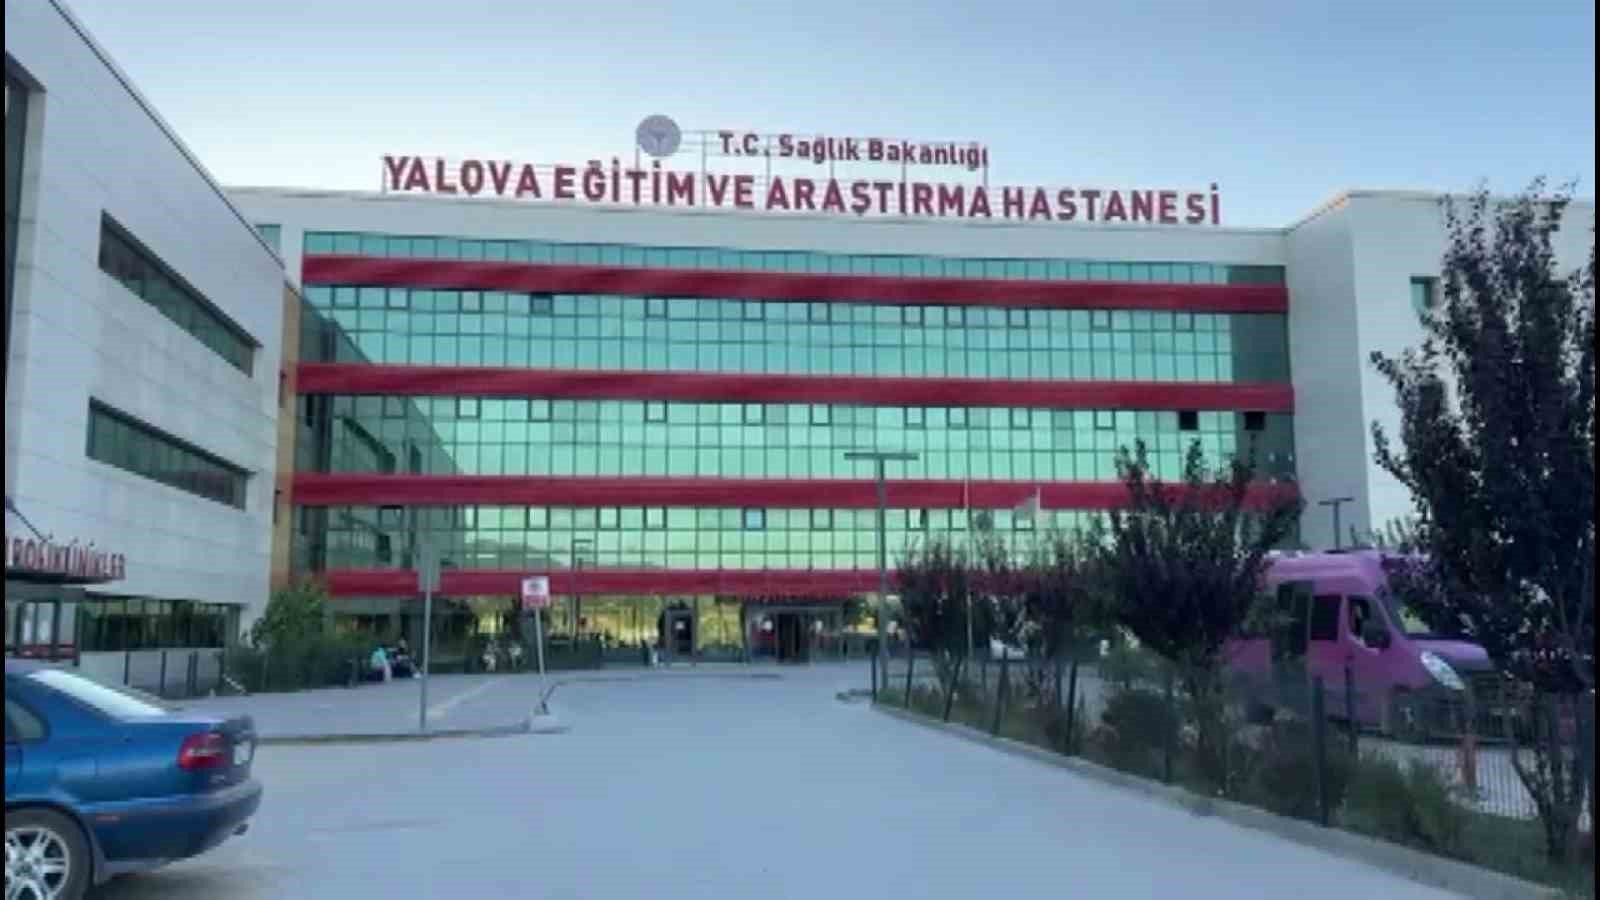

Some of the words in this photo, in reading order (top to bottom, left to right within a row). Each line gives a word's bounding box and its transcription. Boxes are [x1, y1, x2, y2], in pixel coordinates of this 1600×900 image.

[719, 131, 771, 158] T.C.
[779, 134, 861, 164] Sağlık
[868, 137, 989, 171] Bakanlığı
[383, 155, 542, 199] YALOVA
[553, 156, 696, 206] EĞİTİM
[707, 174, 755, 209] VE
[766, 176, 992, 217] ARAŞTIRMA
[1002, 182, 1221, 225] HASTANESİ
